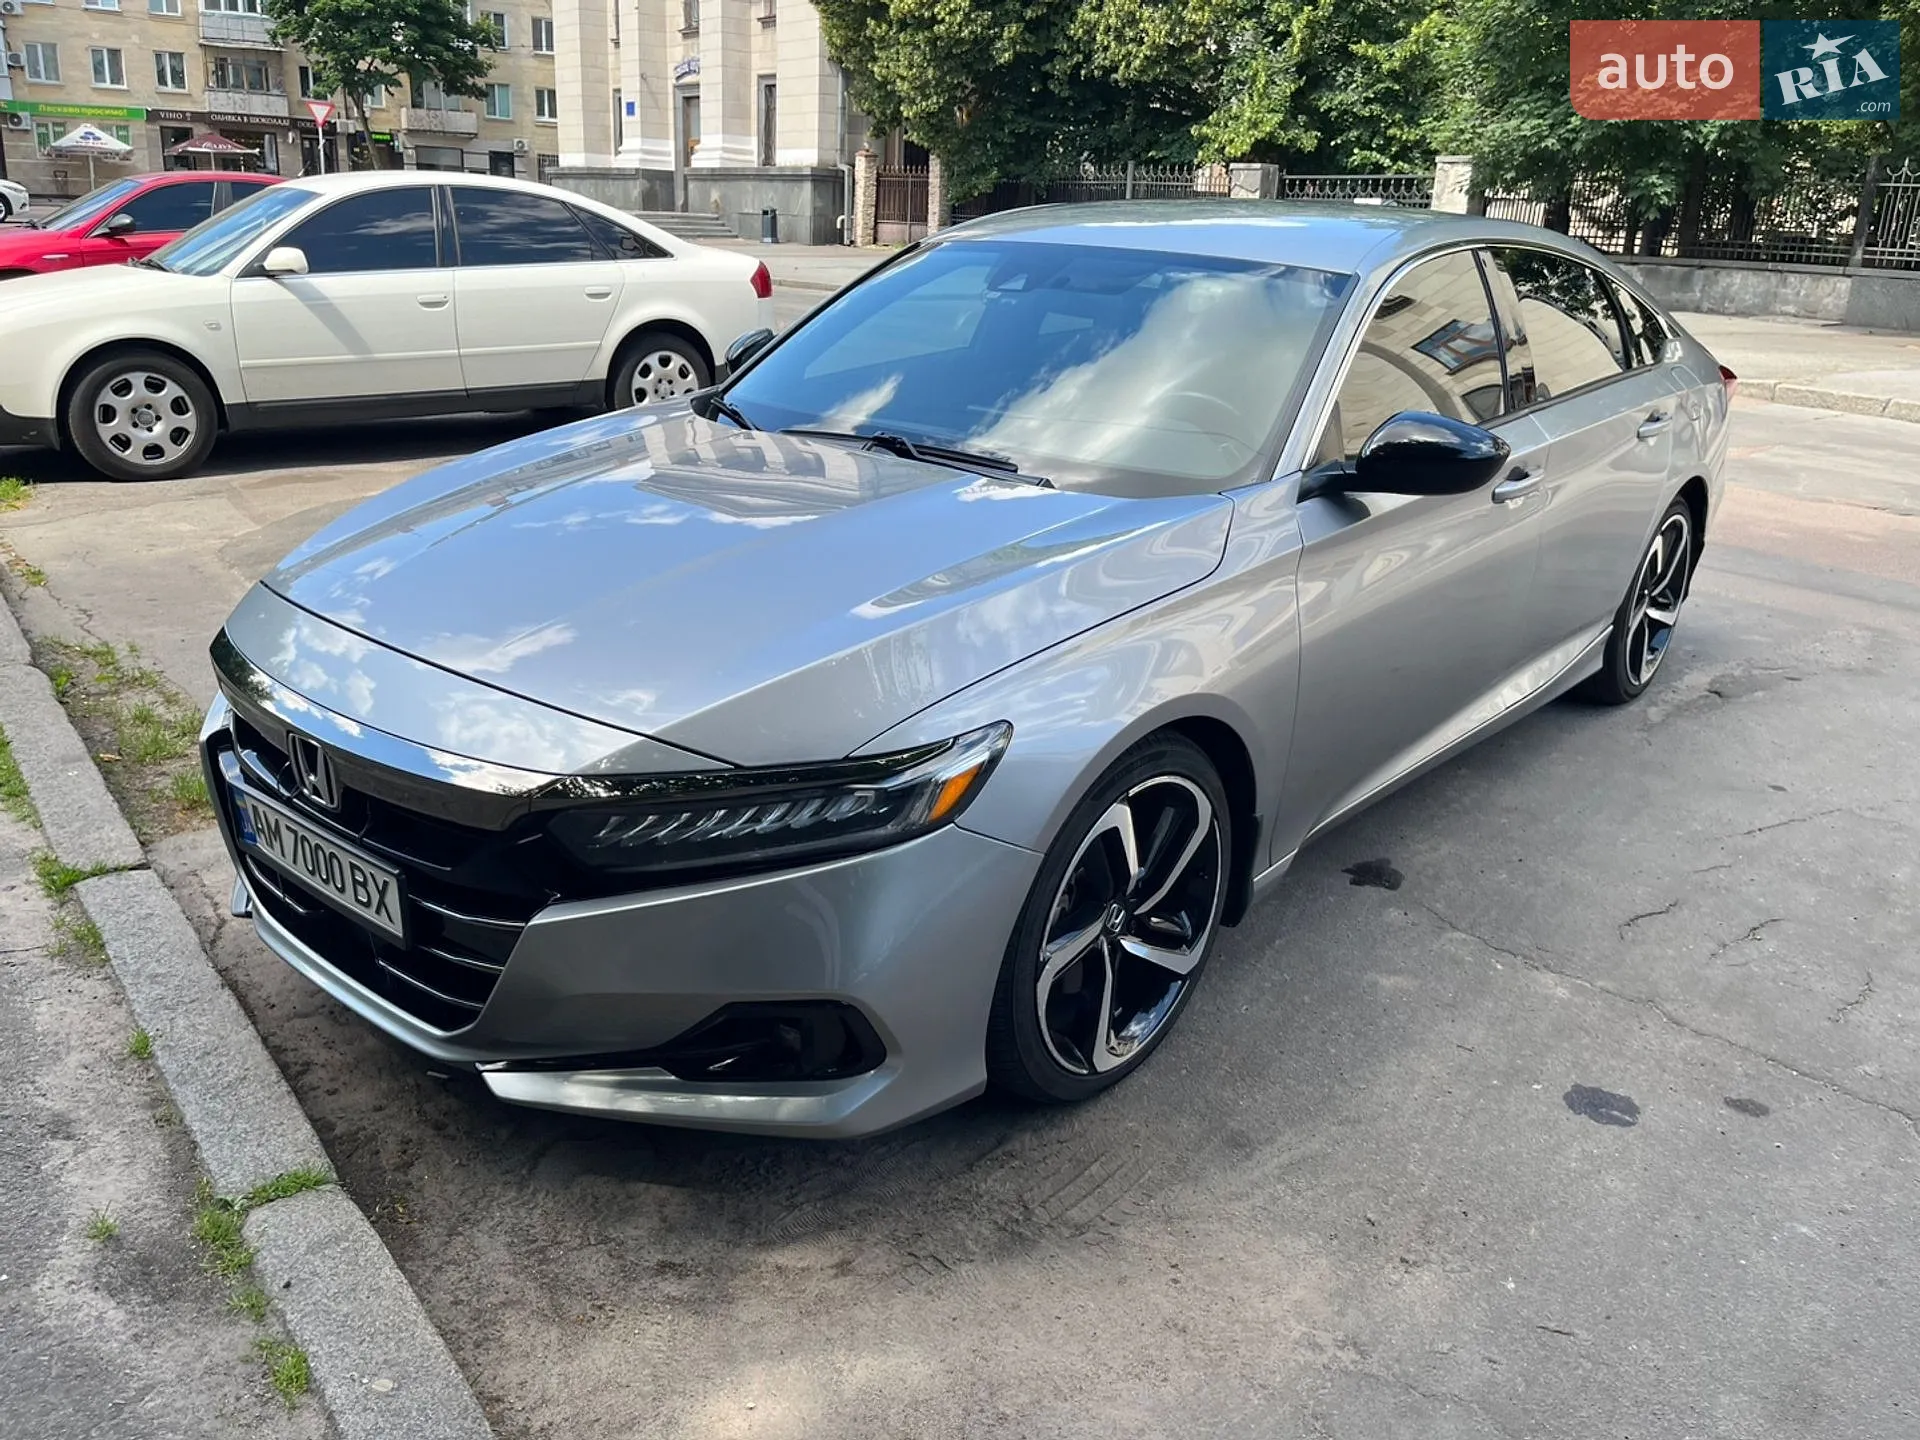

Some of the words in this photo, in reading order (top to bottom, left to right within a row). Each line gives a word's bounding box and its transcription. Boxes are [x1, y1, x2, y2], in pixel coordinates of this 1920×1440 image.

[251, 803, 286, 860] AM
[285, 824, 346, 894] 7000
[348, 860, 396, 924] BX
